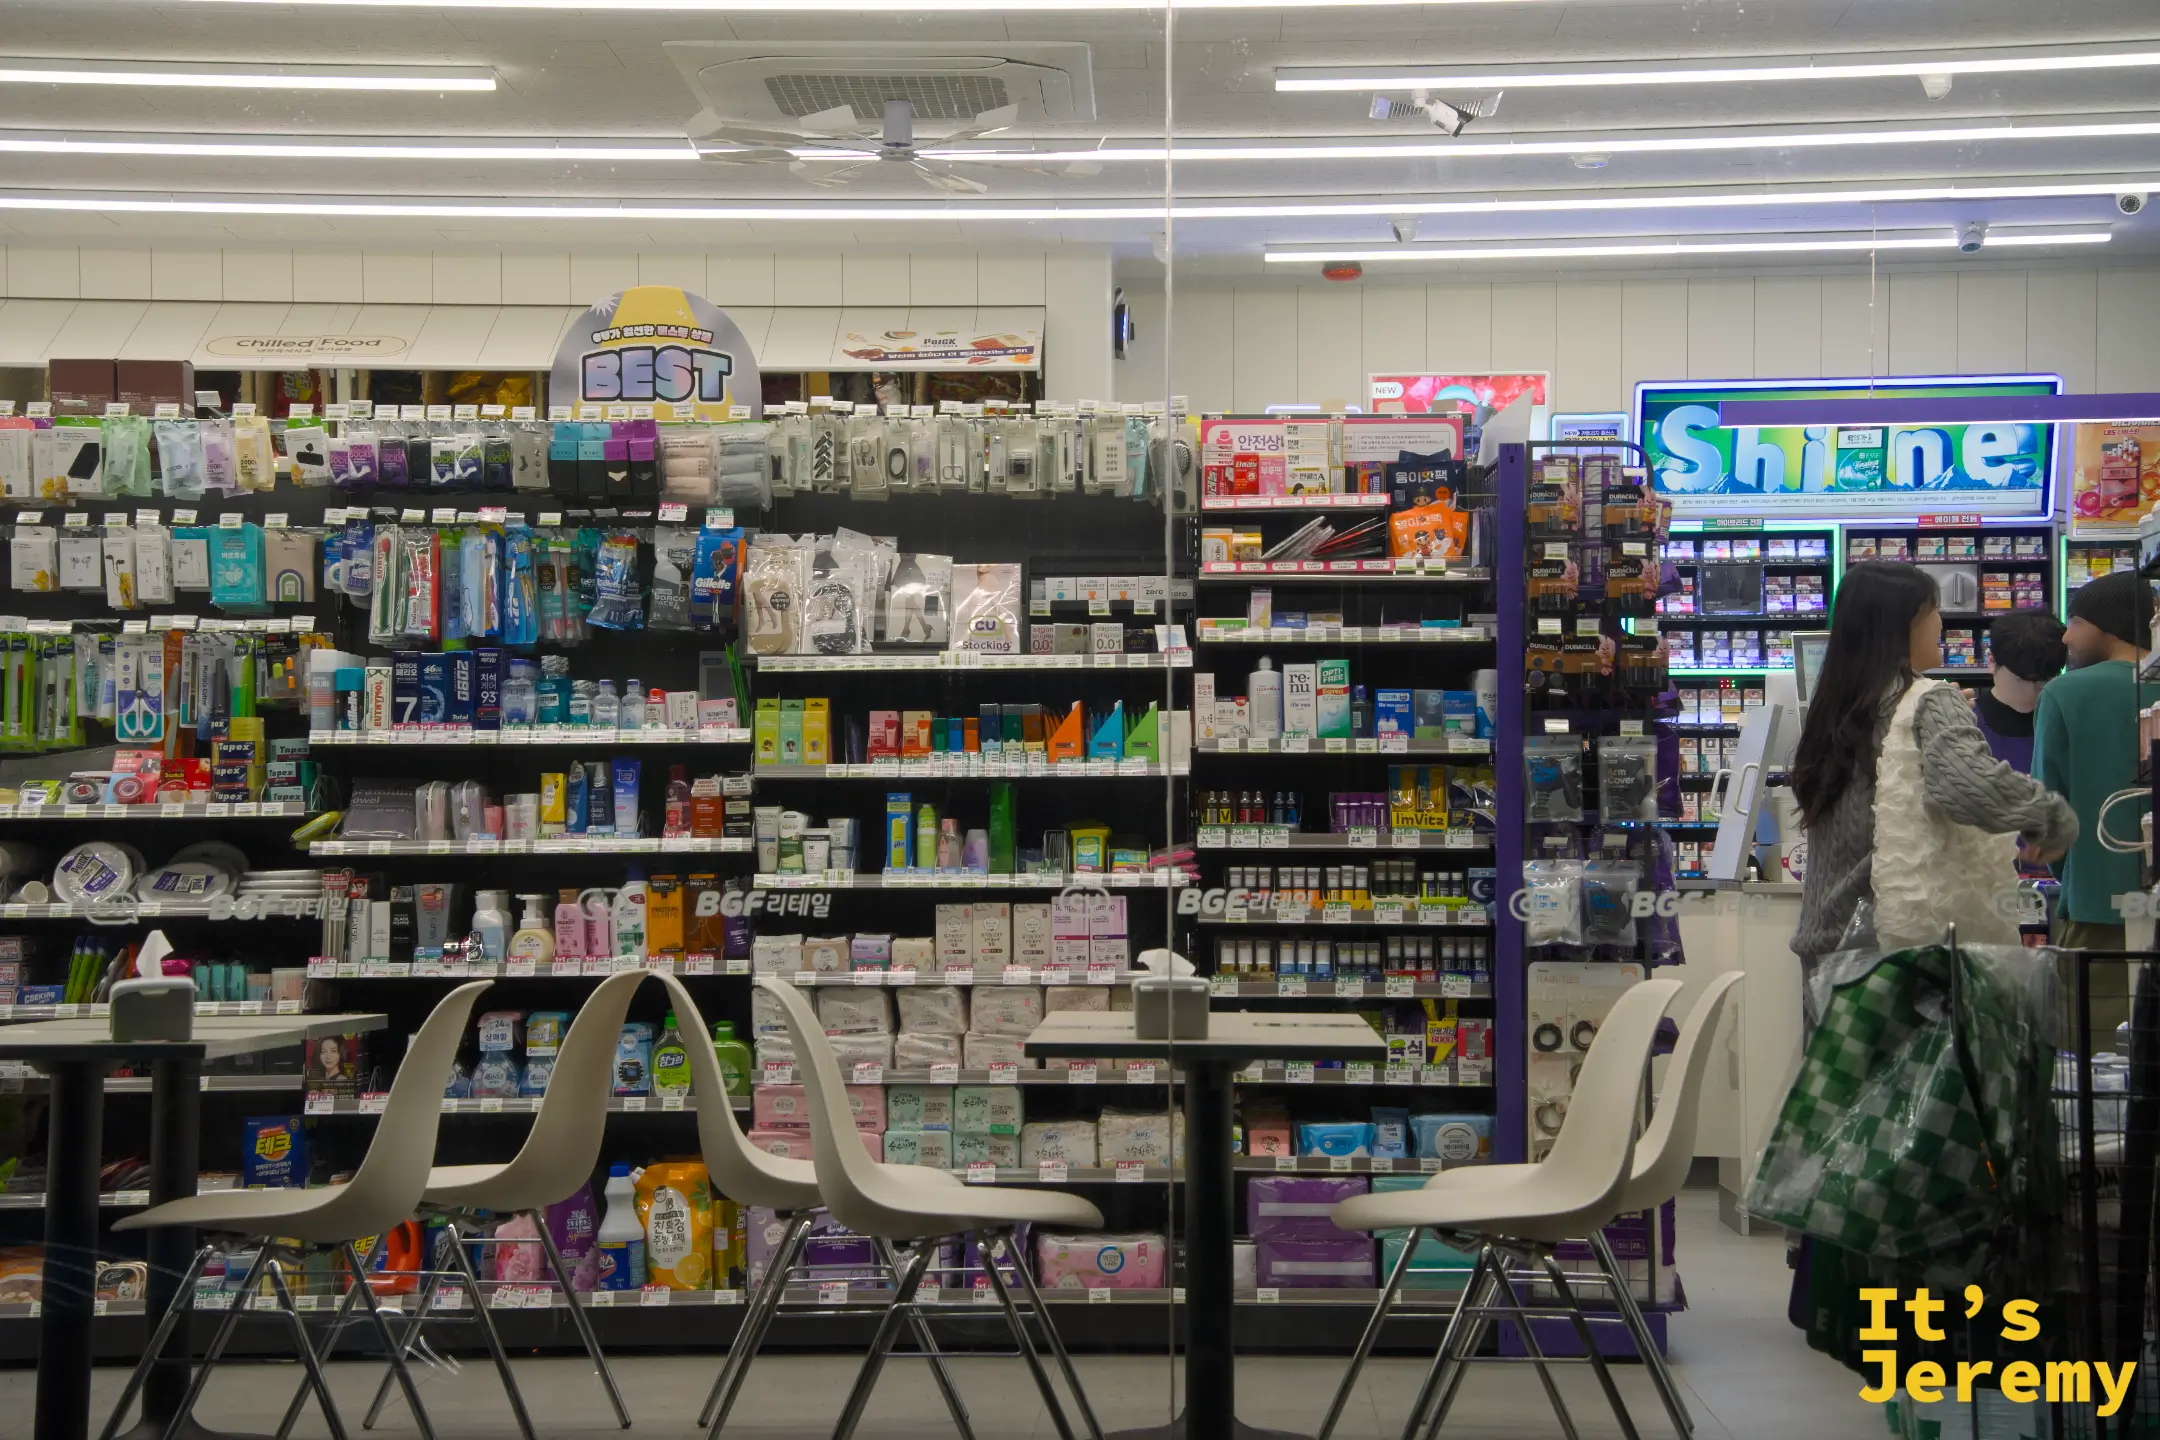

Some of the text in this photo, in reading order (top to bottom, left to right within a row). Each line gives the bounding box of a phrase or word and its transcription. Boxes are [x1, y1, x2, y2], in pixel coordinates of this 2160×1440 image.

[592, 323, 713, 344] CU가 엄선한 베스트 상품
[237, 338, 381, 348] Chilled Food
[582, 345, 733, 401] BEST
[1375, 386, 1397, 395] NEW
[1660, 404, 2030, 493] Shine
[350, 450, 373, 458] SOCKS
[1716, 519, 1749, 527] 하이브리드
[1961, 514, 1978, 523] 전용
[1532, 567, 1562, 575] DURACELL
[1609, 567, 1639, 575] DURACELL
[694, 577, 732, 590] Gillette
[654, 594, 685, 602] DORCO
[974, 620, 995, 631] CU
[1096, 632, 1122, 640] original
[962, 640, 1011, 652] Stocking
[1096, 639, 1122, 650] 0.01
[1565, 643, 1596, 651] DURACELL
[395, 668, 418, 676] 페리오
[480, 672, 497, 681] 치석
[1322, 668, 1343, 677] OPTI-
[456, 659, 470, 701] 2080
[1322, 673, 1344, 684] FREE
[480, 681, 497, 690] 케어
[1289, 683, 1311, 693] nu
[373, 680, 384, 727] EUTHYMOL
[395, 696, 418, 723] 7
[218, 742, 250, 752] Tapex
[213, 767, 240, 777] Tapex
[269, 769, 293, 777] Tapex
[1608, 775, 1636, 784] Cover
[215, 791, 243, 801] Tapex
[273, 793, 302, 801] Tapex
[695, 890, 832, 918] BGF리테일
[494, 1020, 505, 1028] 24
[659, 1054, 683, 1068] 참그린
[255, 1133, 292, 1155] 테크
[654, 1219, 685, 1234] 친환경
